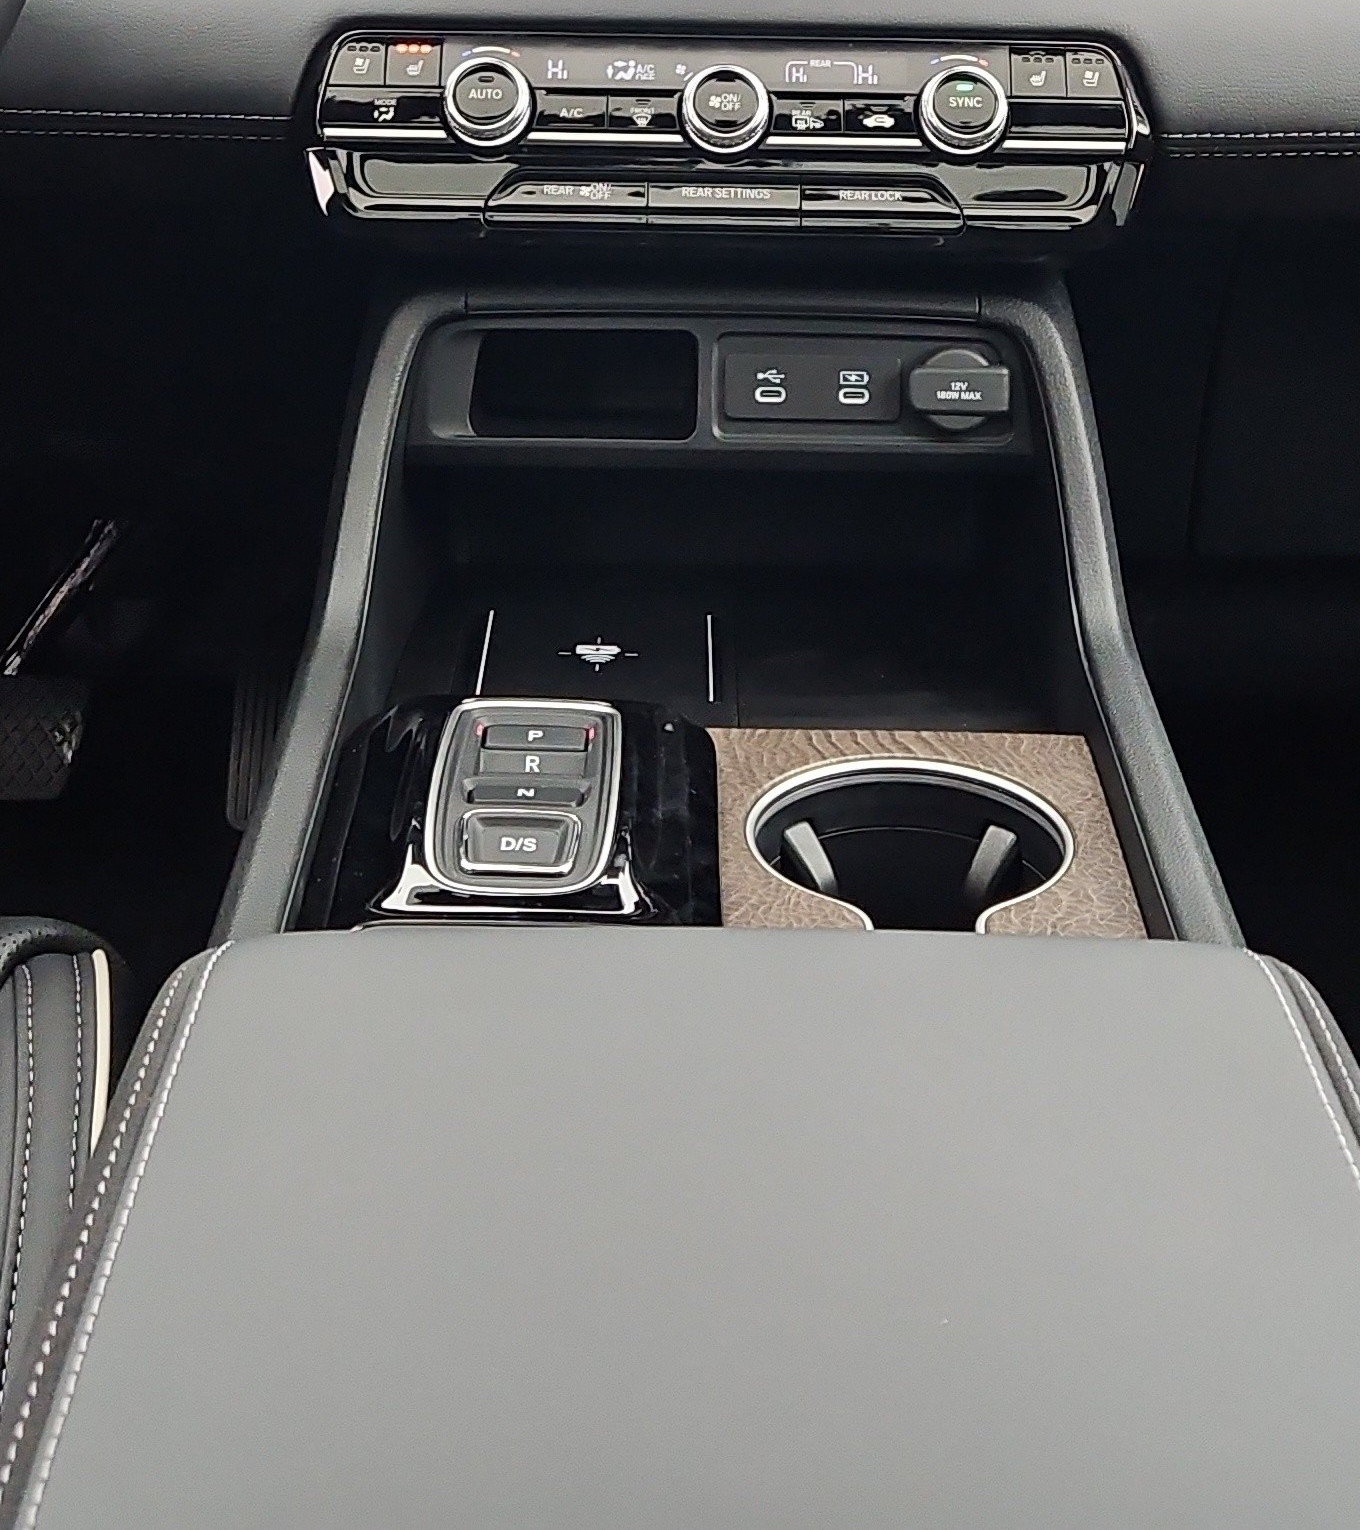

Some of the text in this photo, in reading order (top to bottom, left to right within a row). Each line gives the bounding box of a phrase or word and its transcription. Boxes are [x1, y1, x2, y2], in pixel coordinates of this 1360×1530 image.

[810, 59, 832, 68] REAR
[468, 88, 502, 100] AUTO
[374, 98, 398, 106] MODE
[721, 102, 741, 111] OFF
[949, 95, 983, 109] SYNC
[559, 106, 584, 118] A/C
[543, 185, 574, 195] REAR
[681, 187, 771, 200] REAR SETTINGS
[839, 189, 902, 201] REAR LOCK
[590, 191, 611, 200] OFF
[950, 381, 968, 390] 12V
[961, 391, 983, 400] MAX
[527, 730, 544, 741] P
[525, 756, 540, 773] R
[516, 788, 535, 797] N
[500, 837, 538, 852] D/S
